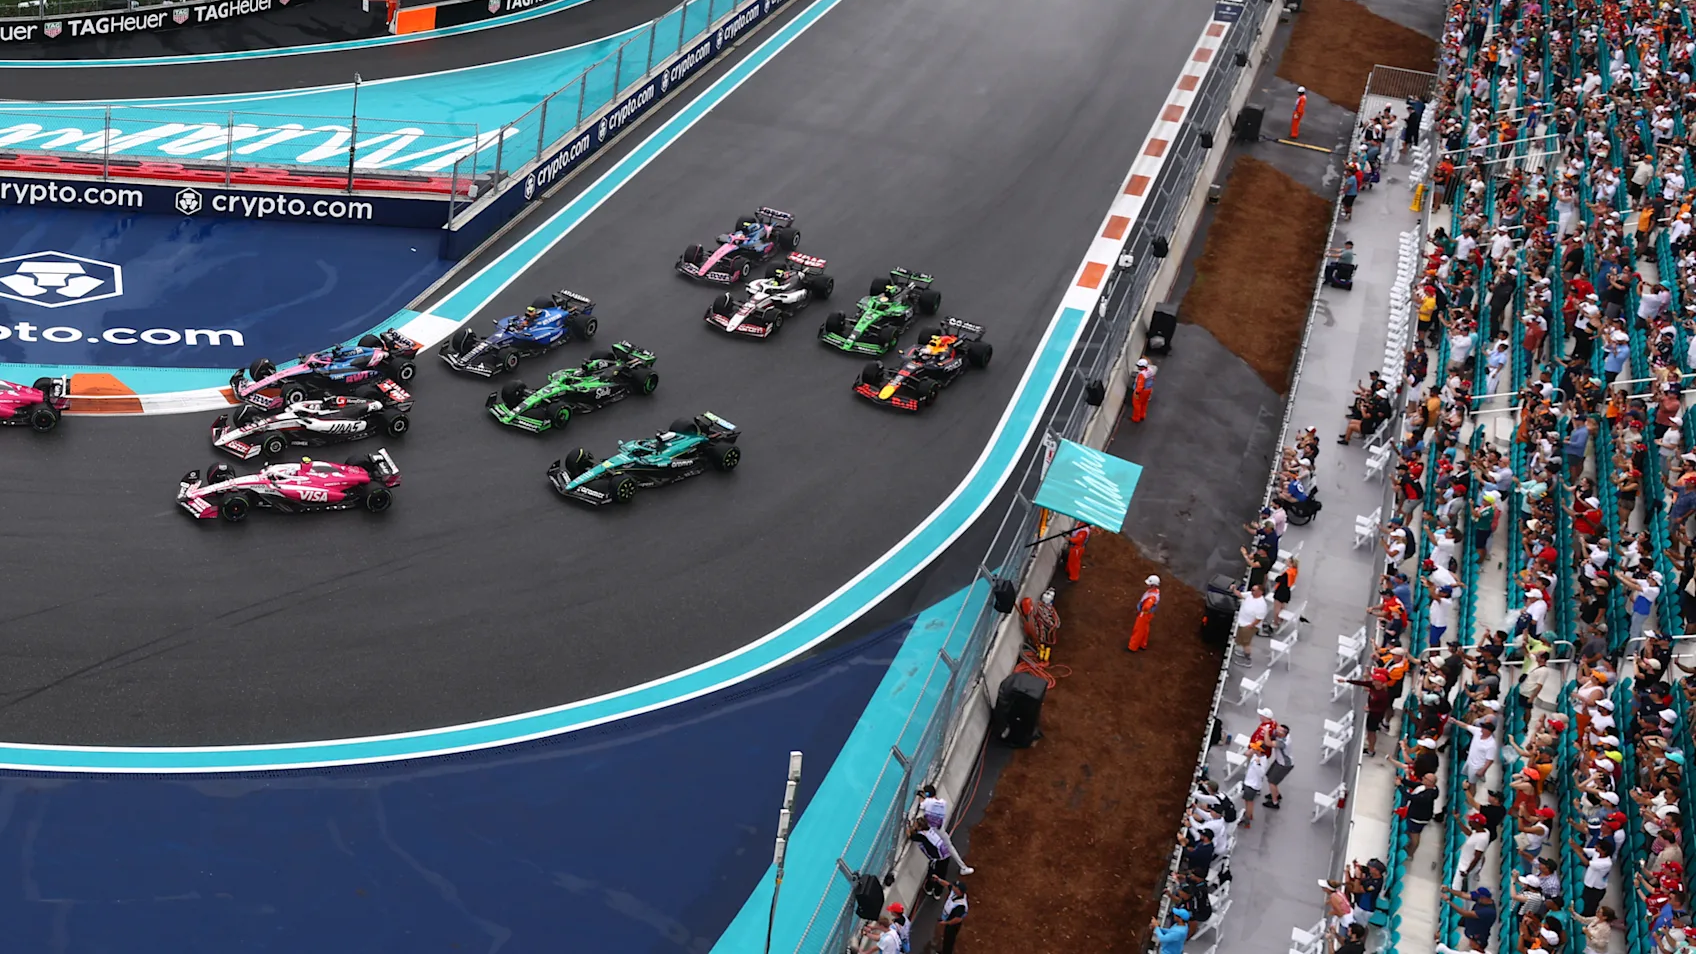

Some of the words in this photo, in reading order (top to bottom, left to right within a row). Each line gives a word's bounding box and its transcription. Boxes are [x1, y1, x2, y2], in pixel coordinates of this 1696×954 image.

[68, 11, 168, 36] TAGHeuer
[723, 4, 760, 41] crypto.com
[670, 40, 711, 83] crypto.com
[608, 83, 655, 131] crypto.com
[537, 134, 590, 187] crypto.com
[211, 193, 373, 220] crypto.com
[297, 490, 328, 503] VISA
